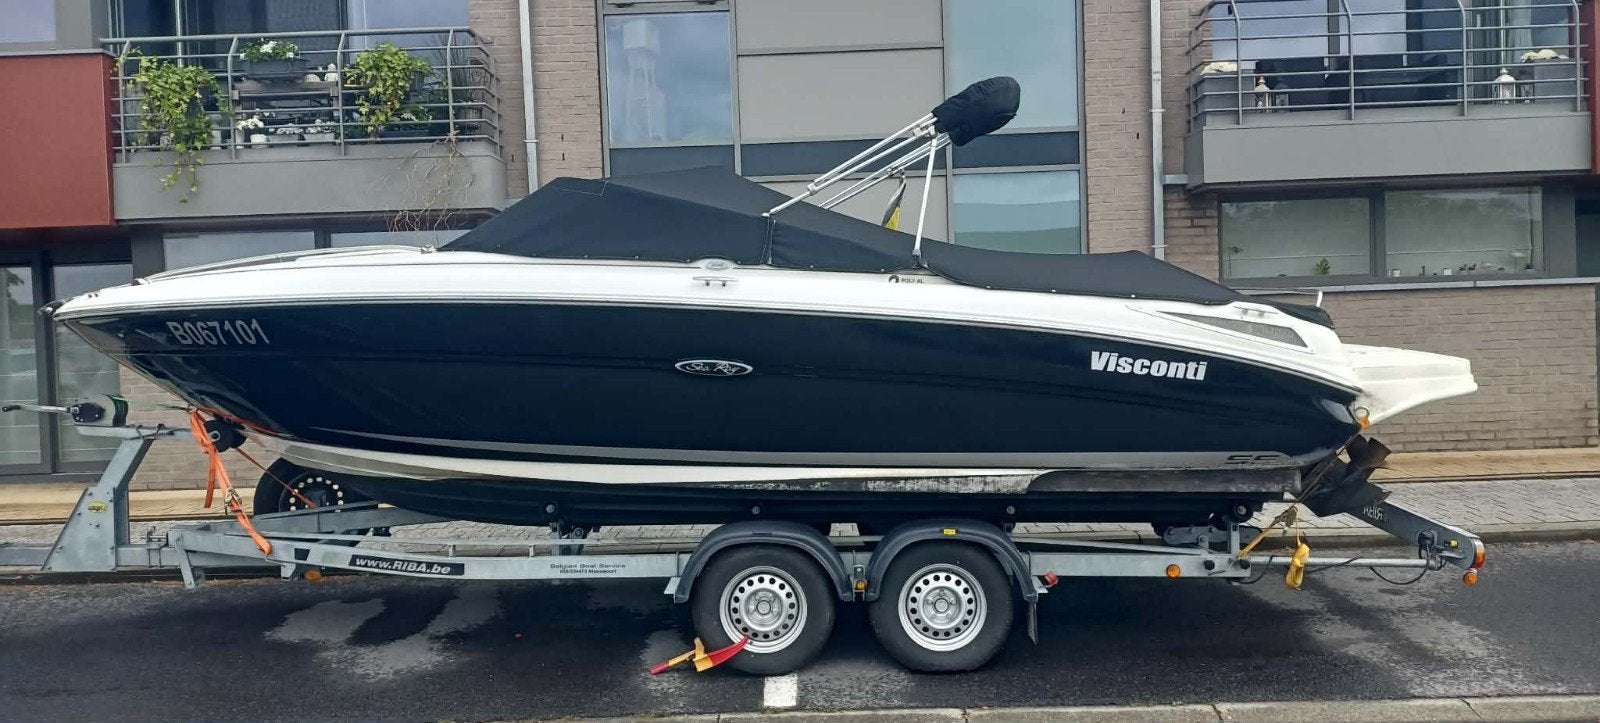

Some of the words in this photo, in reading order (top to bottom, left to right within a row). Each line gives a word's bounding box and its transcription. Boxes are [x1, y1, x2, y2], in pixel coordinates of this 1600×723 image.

[165, 318, 270, 345] B067101
[685, 362, 710, 372] Sea
[713, 362, 740, 375] Ray
[1091, 351, 1207, 380] Visconti
[355, 558, 451, 574] www.RIBA.be
